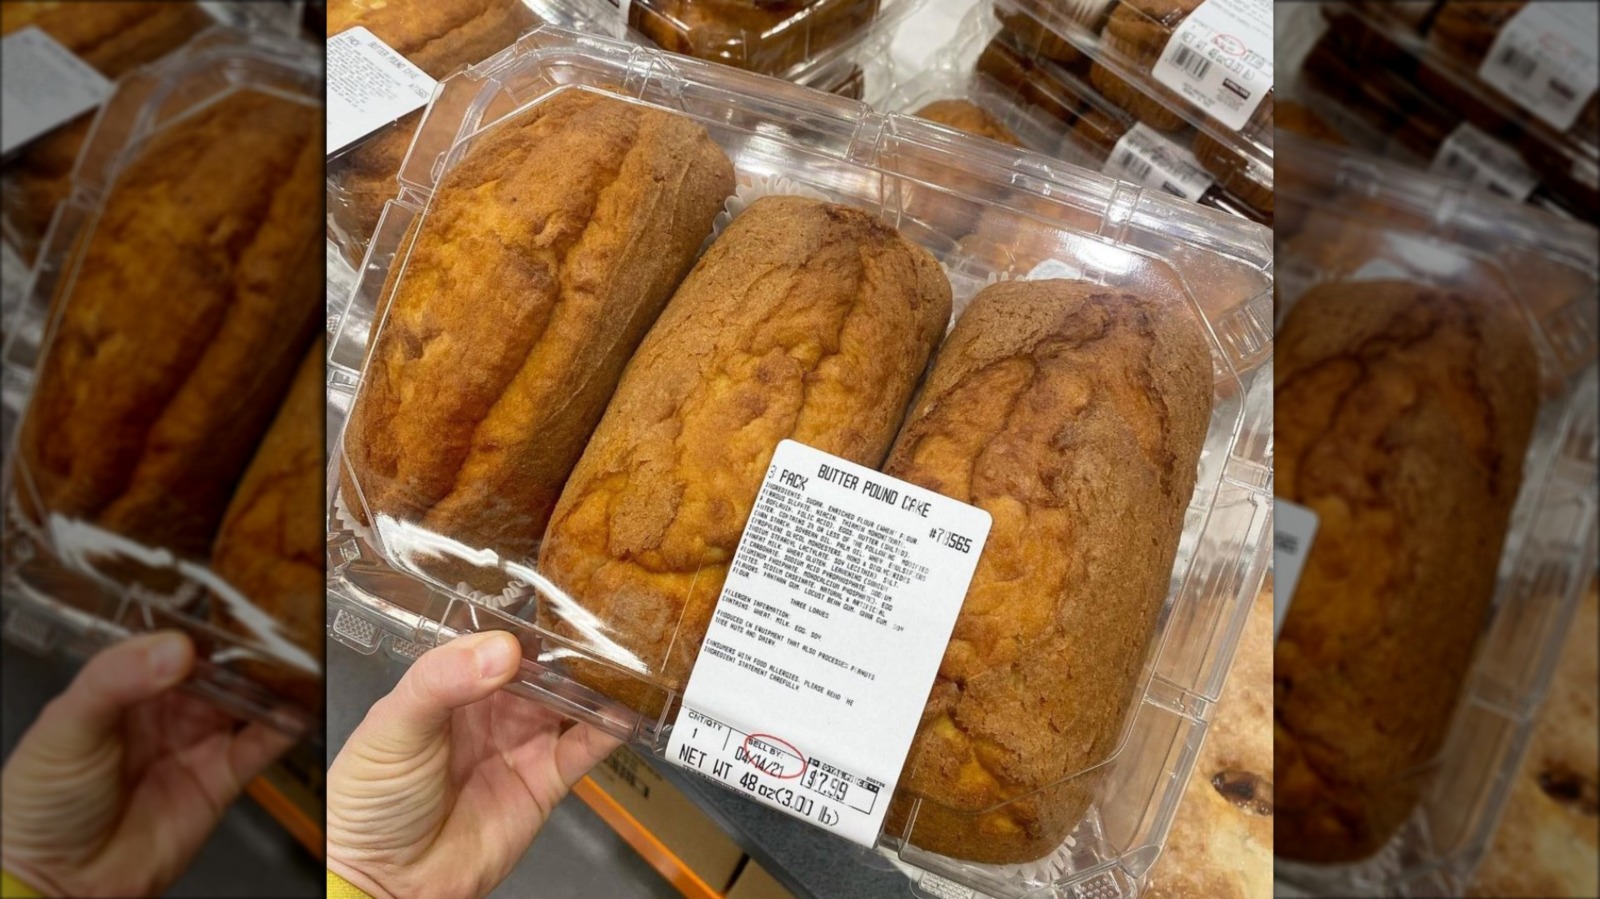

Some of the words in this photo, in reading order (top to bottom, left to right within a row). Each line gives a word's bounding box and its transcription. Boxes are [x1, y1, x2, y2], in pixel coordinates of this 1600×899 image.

[778, 468, 809, 491] PACK
[817, 463, 859, 491] BUTTER
[861, 480, 898, 505] POUND
[901, 495, 931, 518] CAKE
[797, 509, 814, 521] FOLIC
[828, 505, 854, 520] ENRICHED
[857, 516, 874, 527] FLOUR
[785, 530, 804, 543] GLYCOL
[795, 525, 818, 538] SOYBEAN
[836, 541, 850, 551] PALM
[826, 530, 840, 539] LESS
[786, 548, 803, 557] WHEAT
[834, 557, 844, 565] SOY
[784, 554, 804, 566] SODIUM
[806, 563, 820, 573] ACID
[804, 588, 824, 599] LOCUST
[826, 597, 841, 606] BEAN
[881, 602, 892, 611] EGG
[790, 598, 806, 609] THREE
[808, 606, 829, 618] LOAVES
[730, 623, 743, 633] NUTS
[787, 638, 800, 648] THAT
[801, 645, 816, 655] ALSO
[753, 658, 767, 668] FOOD
[803, 680, 824, 693] PLEASE
[845, 698, 854, 706] HE
[687, 710, 723, 731] CNT/QTY
[692, 727, 698, 738] 1
[747, 738, 769, 752] SELL
[768, 747, 784, 759] BY:
[734, 745, 784, 779] 04/14/21
[678, 743, 707, 768] NET
[712, 758, 733, 780] WT
[739, 771, 758, 792] 48
[817, 805, 839, 826] lb)
